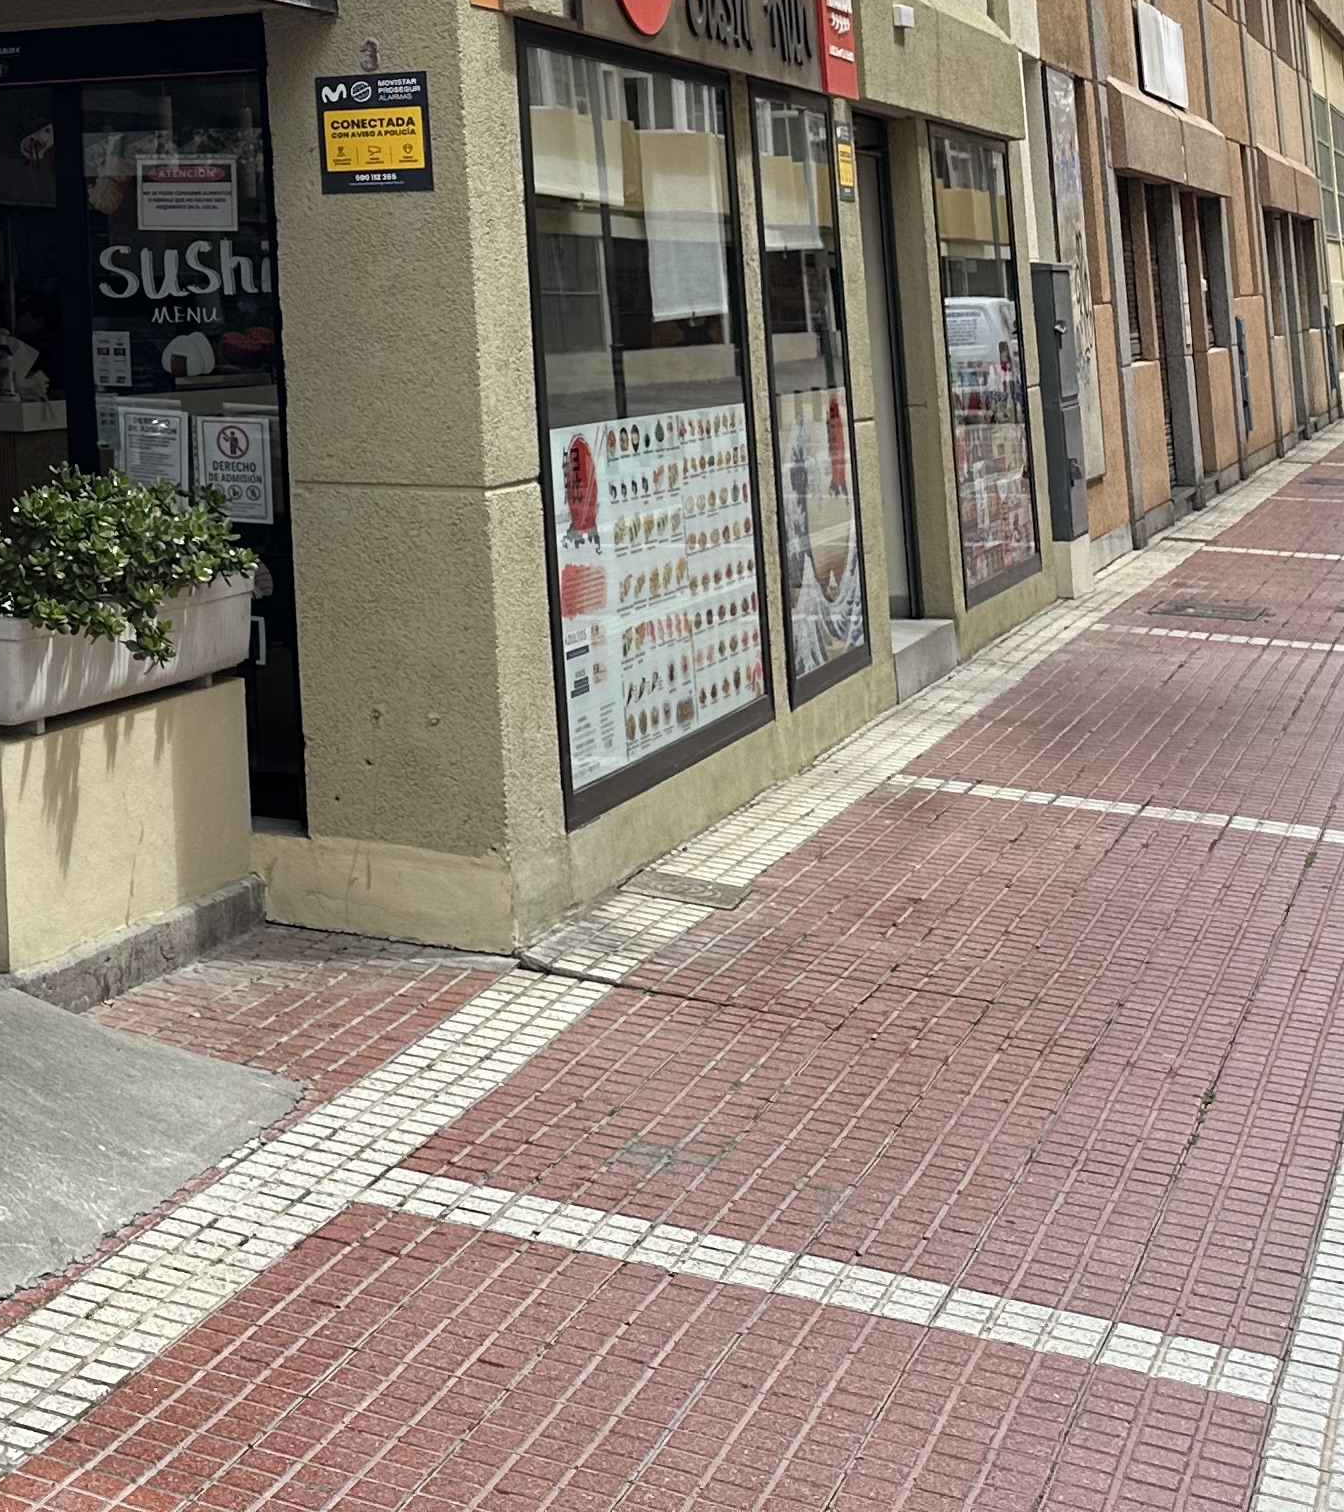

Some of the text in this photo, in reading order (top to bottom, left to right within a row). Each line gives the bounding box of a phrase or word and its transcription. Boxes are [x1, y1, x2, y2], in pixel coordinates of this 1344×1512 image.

[377, 78, 417, 87] MOVISTAR
[378, 85, 421, 94] PROSEGUR
[331, 116, 416, 131] CONECTADA
[151, 306, 221, 323] MENU
[213, 461, 257, 473] DERECHO
